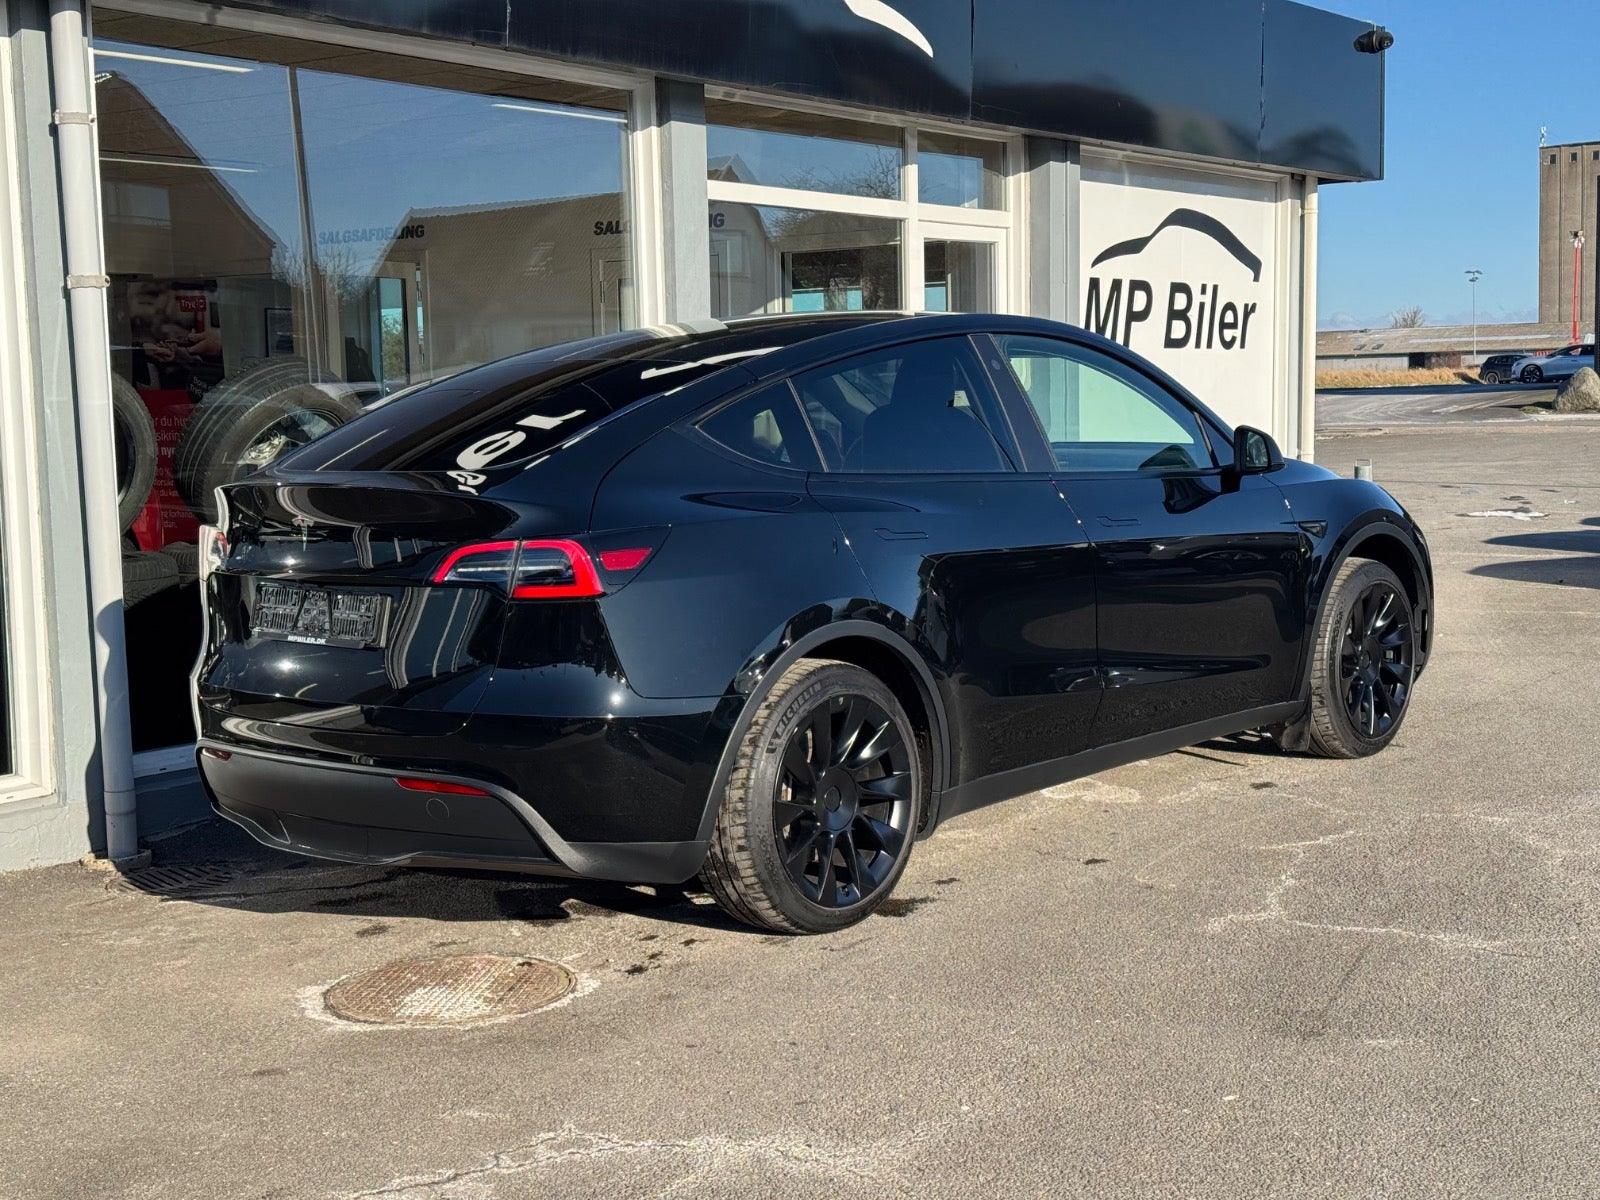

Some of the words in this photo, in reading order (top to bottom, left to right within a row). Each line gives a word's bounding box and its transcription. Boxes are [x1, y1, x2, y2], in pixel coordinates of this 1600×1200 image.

[1084, 276, 1153, 350] MP
[1163, 281, 1257, 351] Biler
[775, 682, 822, 737] MICHELIN
